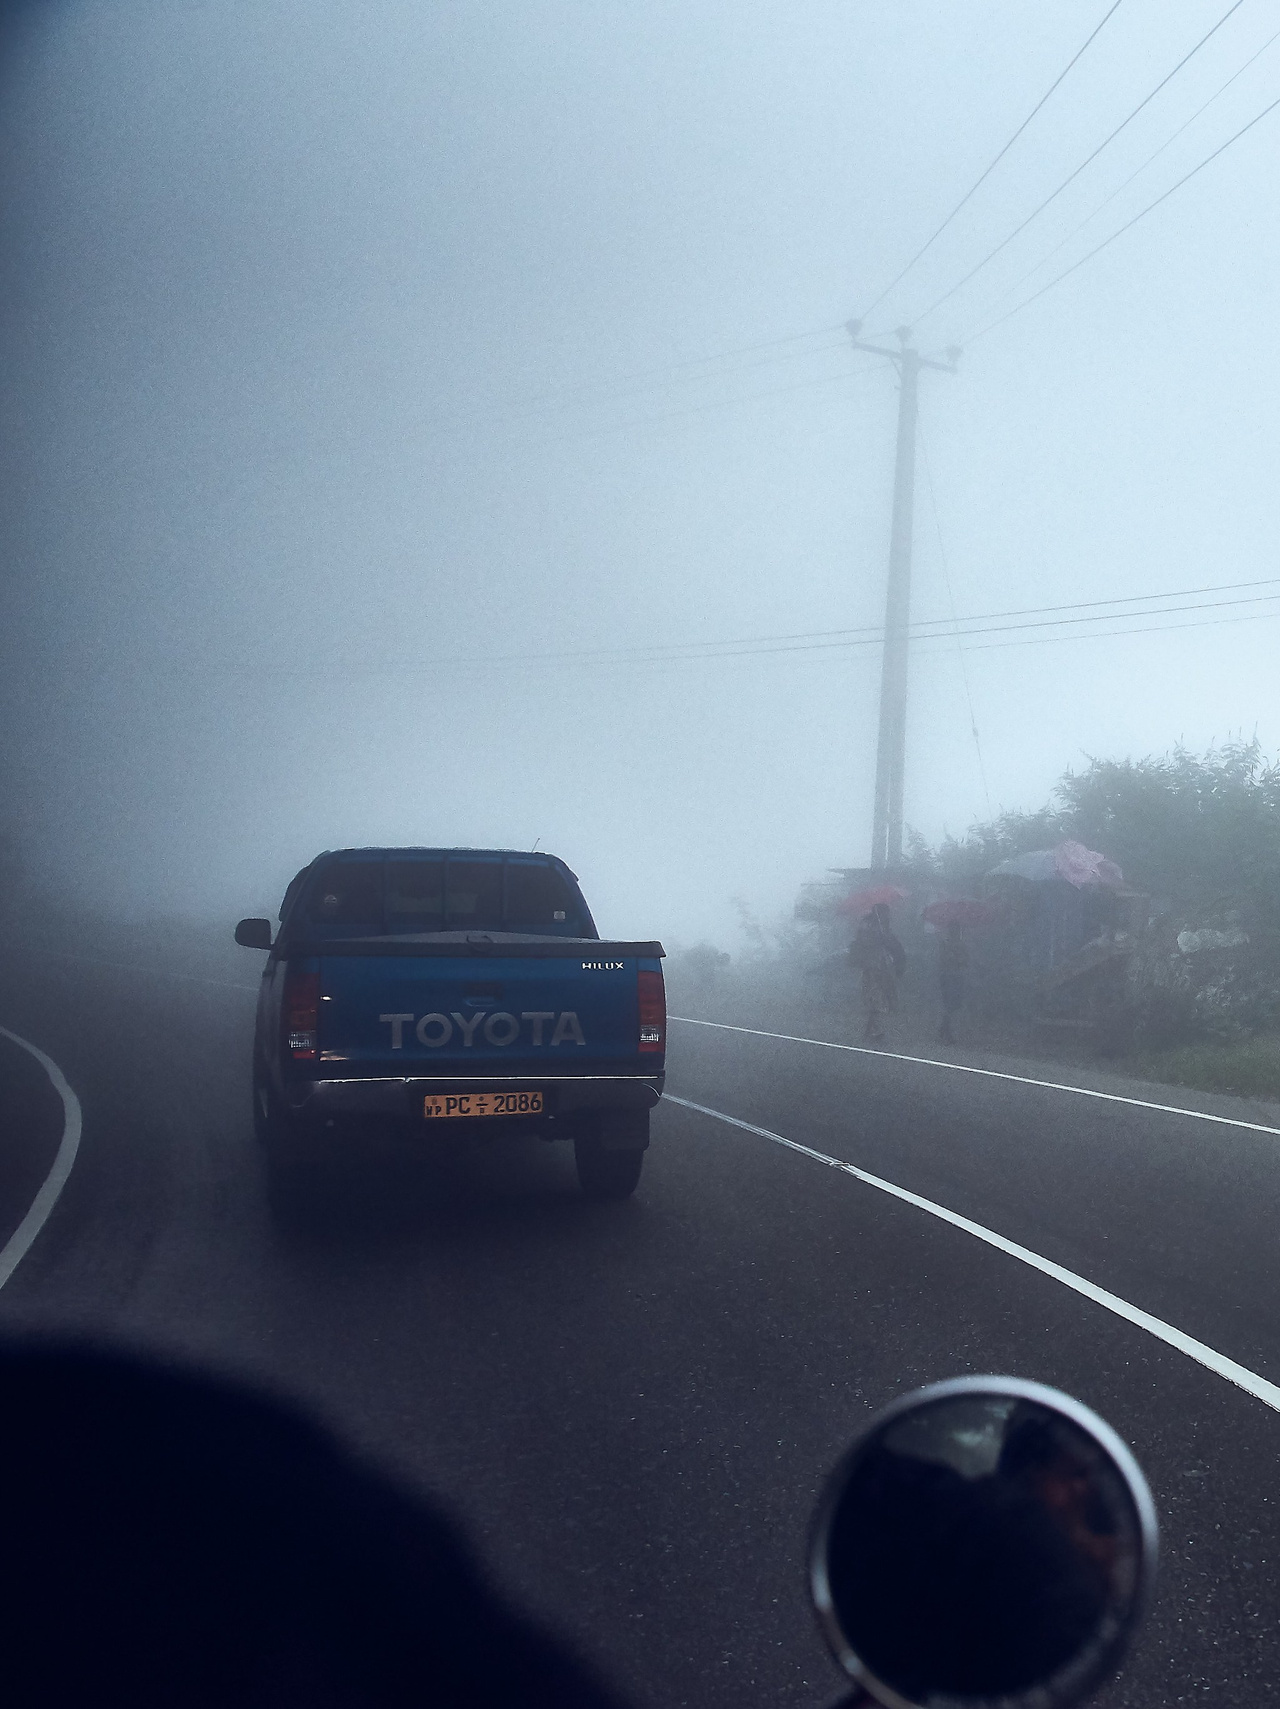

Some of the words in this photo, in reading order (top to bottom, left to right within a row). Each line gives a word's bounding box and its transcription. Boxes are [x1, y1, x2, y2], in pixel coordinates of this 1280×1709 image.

[582, 962, 624, 970] HILUX
[379, 1011, 586, 1049] TOYOTA
[493, 1093, 541, 1113] 2086
